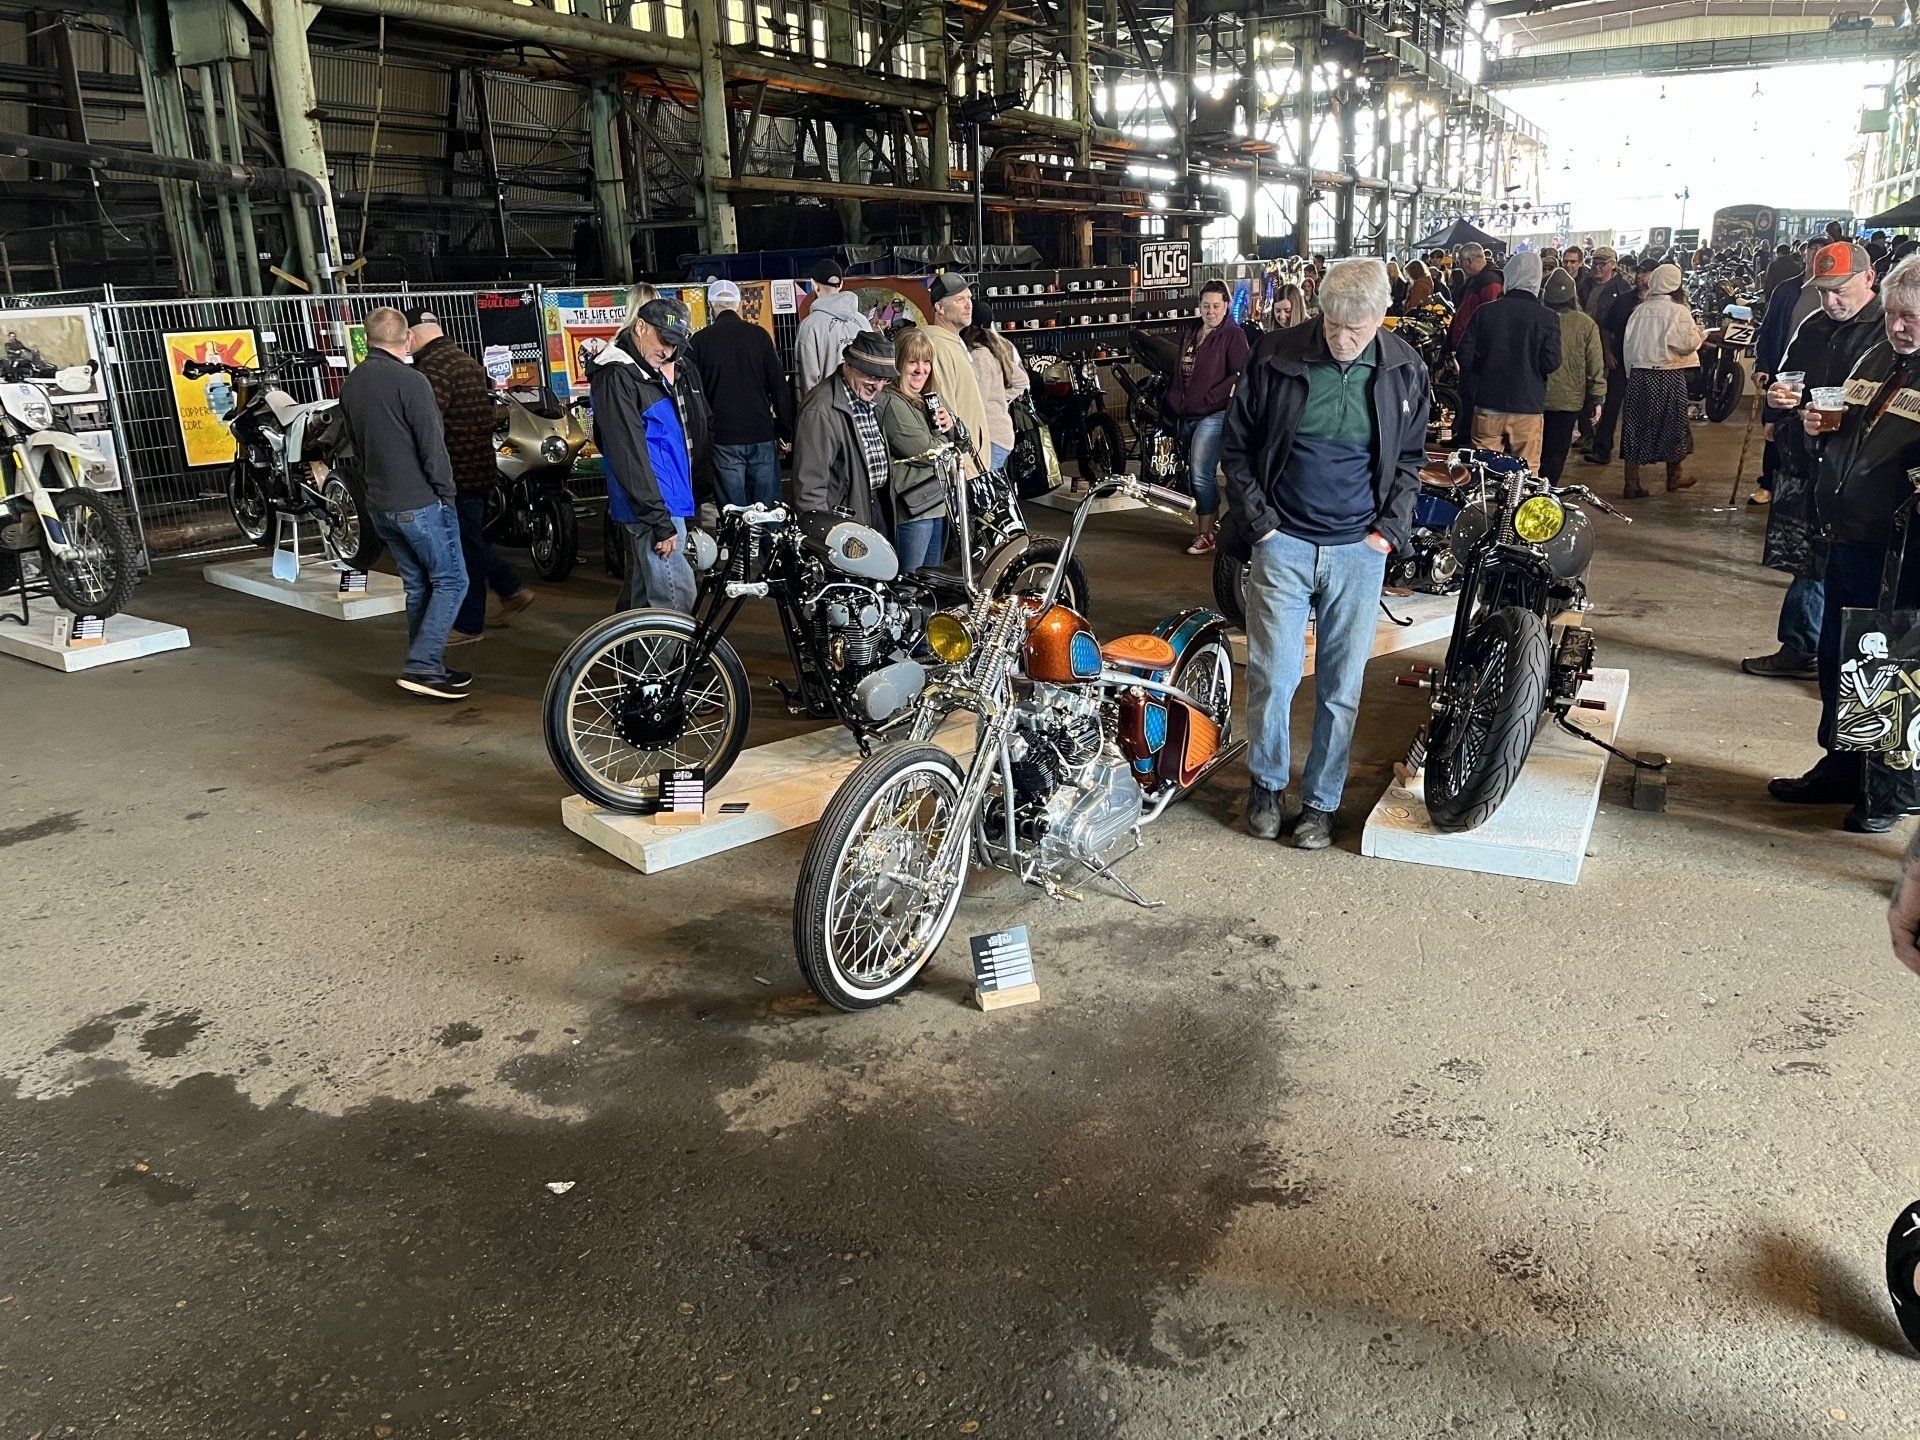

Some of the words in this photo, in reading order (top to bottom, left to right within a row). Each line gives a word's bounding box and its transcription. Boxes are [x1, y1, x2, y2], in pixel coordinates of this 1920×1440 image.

[1143, 245, 1157, 253] CAMP
[478, 299, 504, 309] BULL
[504, 298, 520, 308] RUN
[573, 309, 589, 320] THE
[591, 309, 607, 319] LIFE
[609, 307, 627, 319] CYCL
[488, 362, 509, 374] $500
[180, 406, 209, 418] COPPER
[182, 420, 204, 431] CORE
[1150, 452, 1175, 472] RIDE
[1160, 463, 1178, 477] ON
